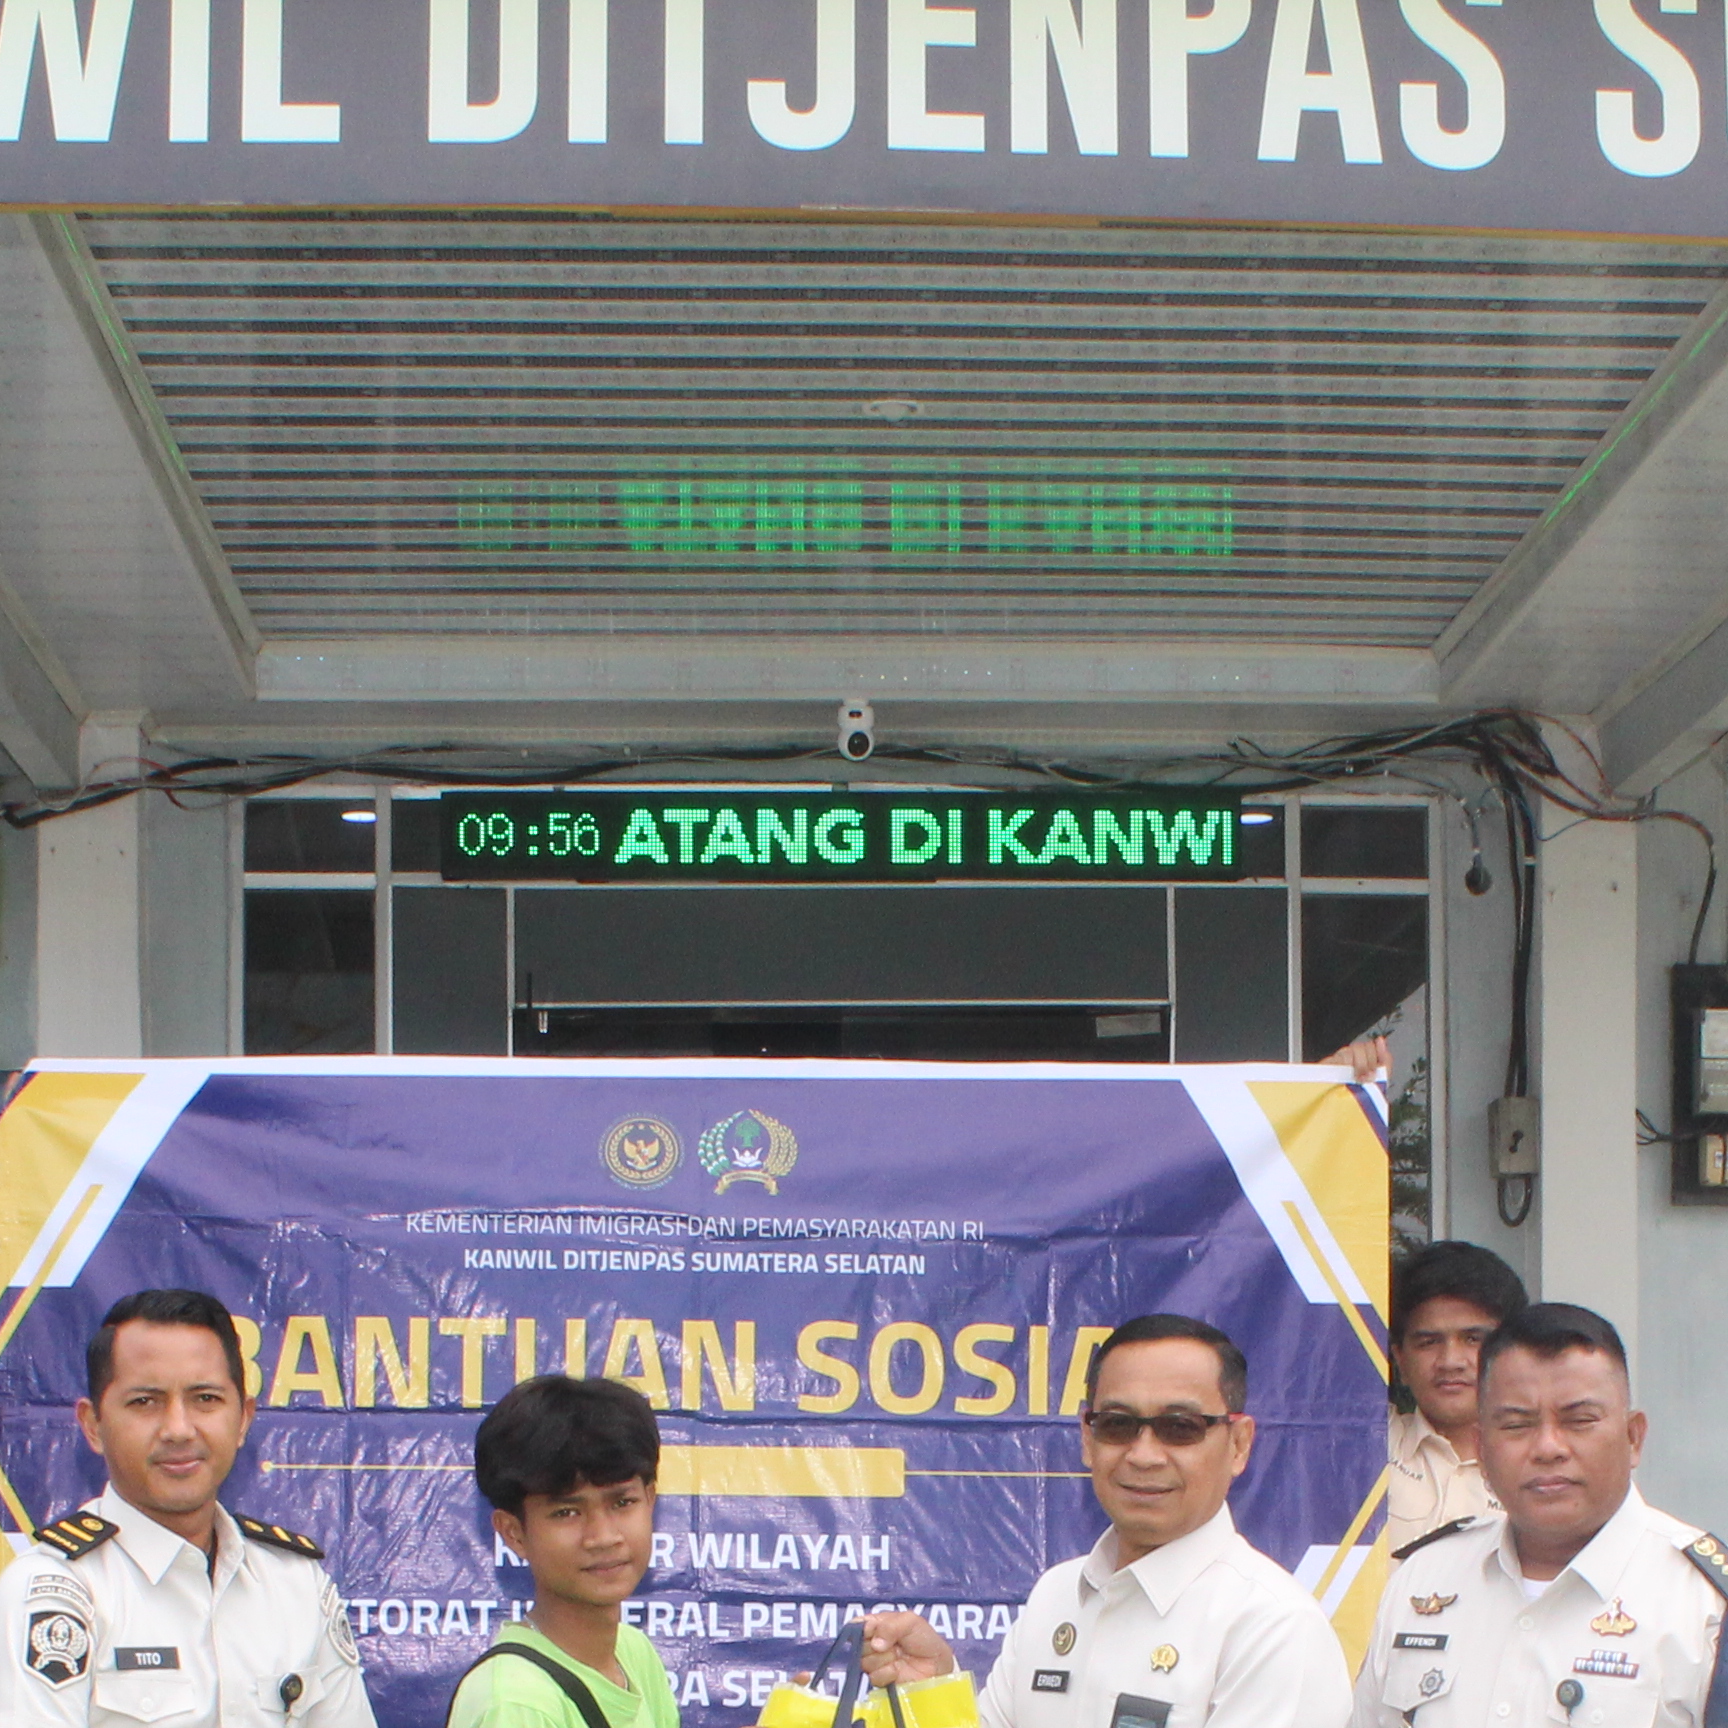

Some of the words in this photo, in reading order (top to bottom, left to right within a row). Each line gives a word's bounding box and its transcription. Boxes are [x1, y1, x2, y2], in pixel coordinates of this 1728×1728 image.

[426, 0, 1506, 171] DITJENPAS
[457, 812, 601, 857] 09:56
[615, 808, 865, 865] ATANG
[891, 808, 962, 865] DI
[987, 808, 1234, 866] KANWI
[405, 1211, 573, 1236] KEMENTERIAN
[578, 1213, 684, 1240] IMIGRASI
[687, 1215, 736, 1240] DAN
[741, 1216, 959, 1242] PEMASYARAKATAN
[962, 1220, 985, 1243] RI
[464, 1247, 558, 1271] KANWIL
[562, 1248, 686, 1273] DITJENPAS
[690, 1250, 819, 1274] SUMATERA
[823, 1251, 927, 1276] SELATAN
[796, 1321, 1115, 1417] SOSIA
[687, 1532, 891, 1571] WILAYAH
[135, 1652, 162, 1666] TITO
